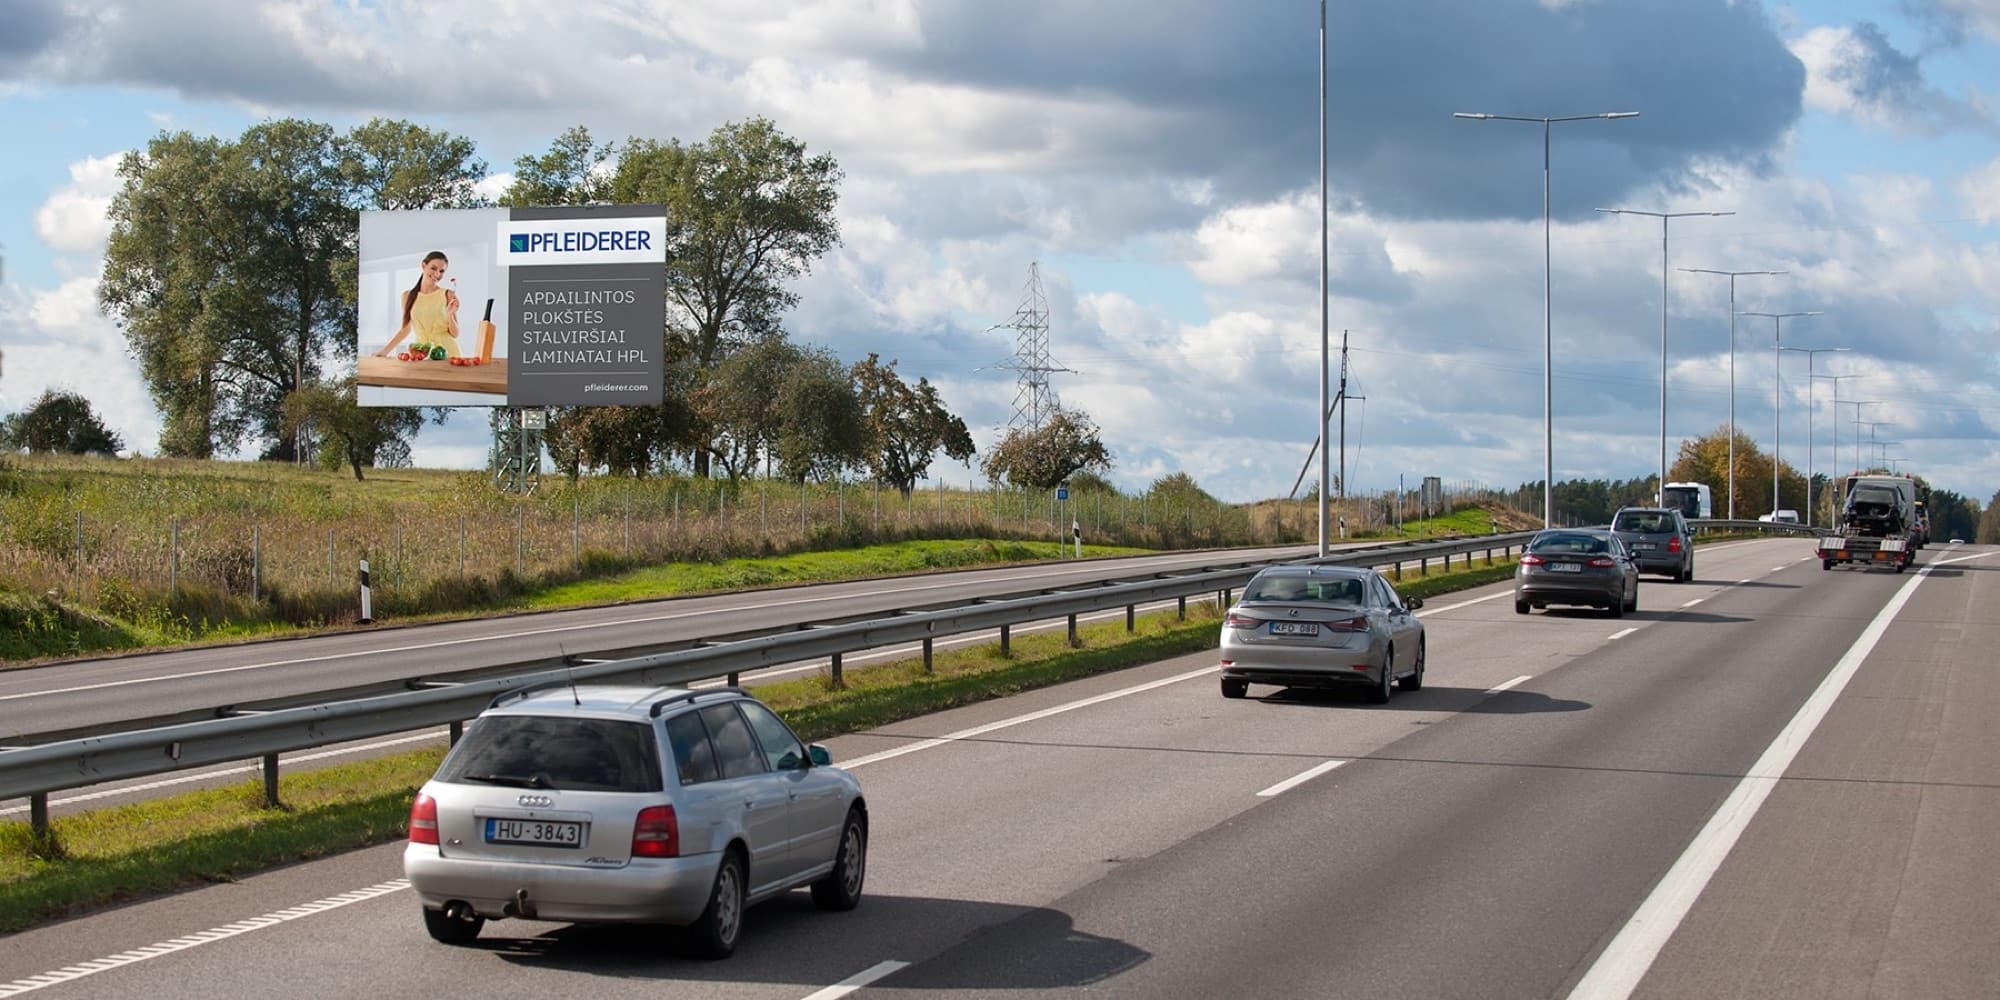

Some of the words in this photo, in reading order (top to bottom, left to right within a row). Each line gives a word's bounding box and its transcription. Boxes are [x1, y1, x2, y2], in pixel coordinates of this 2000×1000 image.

[531, 231, 651, 252] PFLEIDERER
[523, 291, 635, 305] APDAILINTOS
[523, 309, 604, 325] PLOKŠTĖS
[522, 328, 625, 344] STALVIRŠIAI
[522, 350, 612, 364] LAMINATAI
[617, 350, 648, 363] HPL
[584, 383, 648, 392] pfleiderer.com
